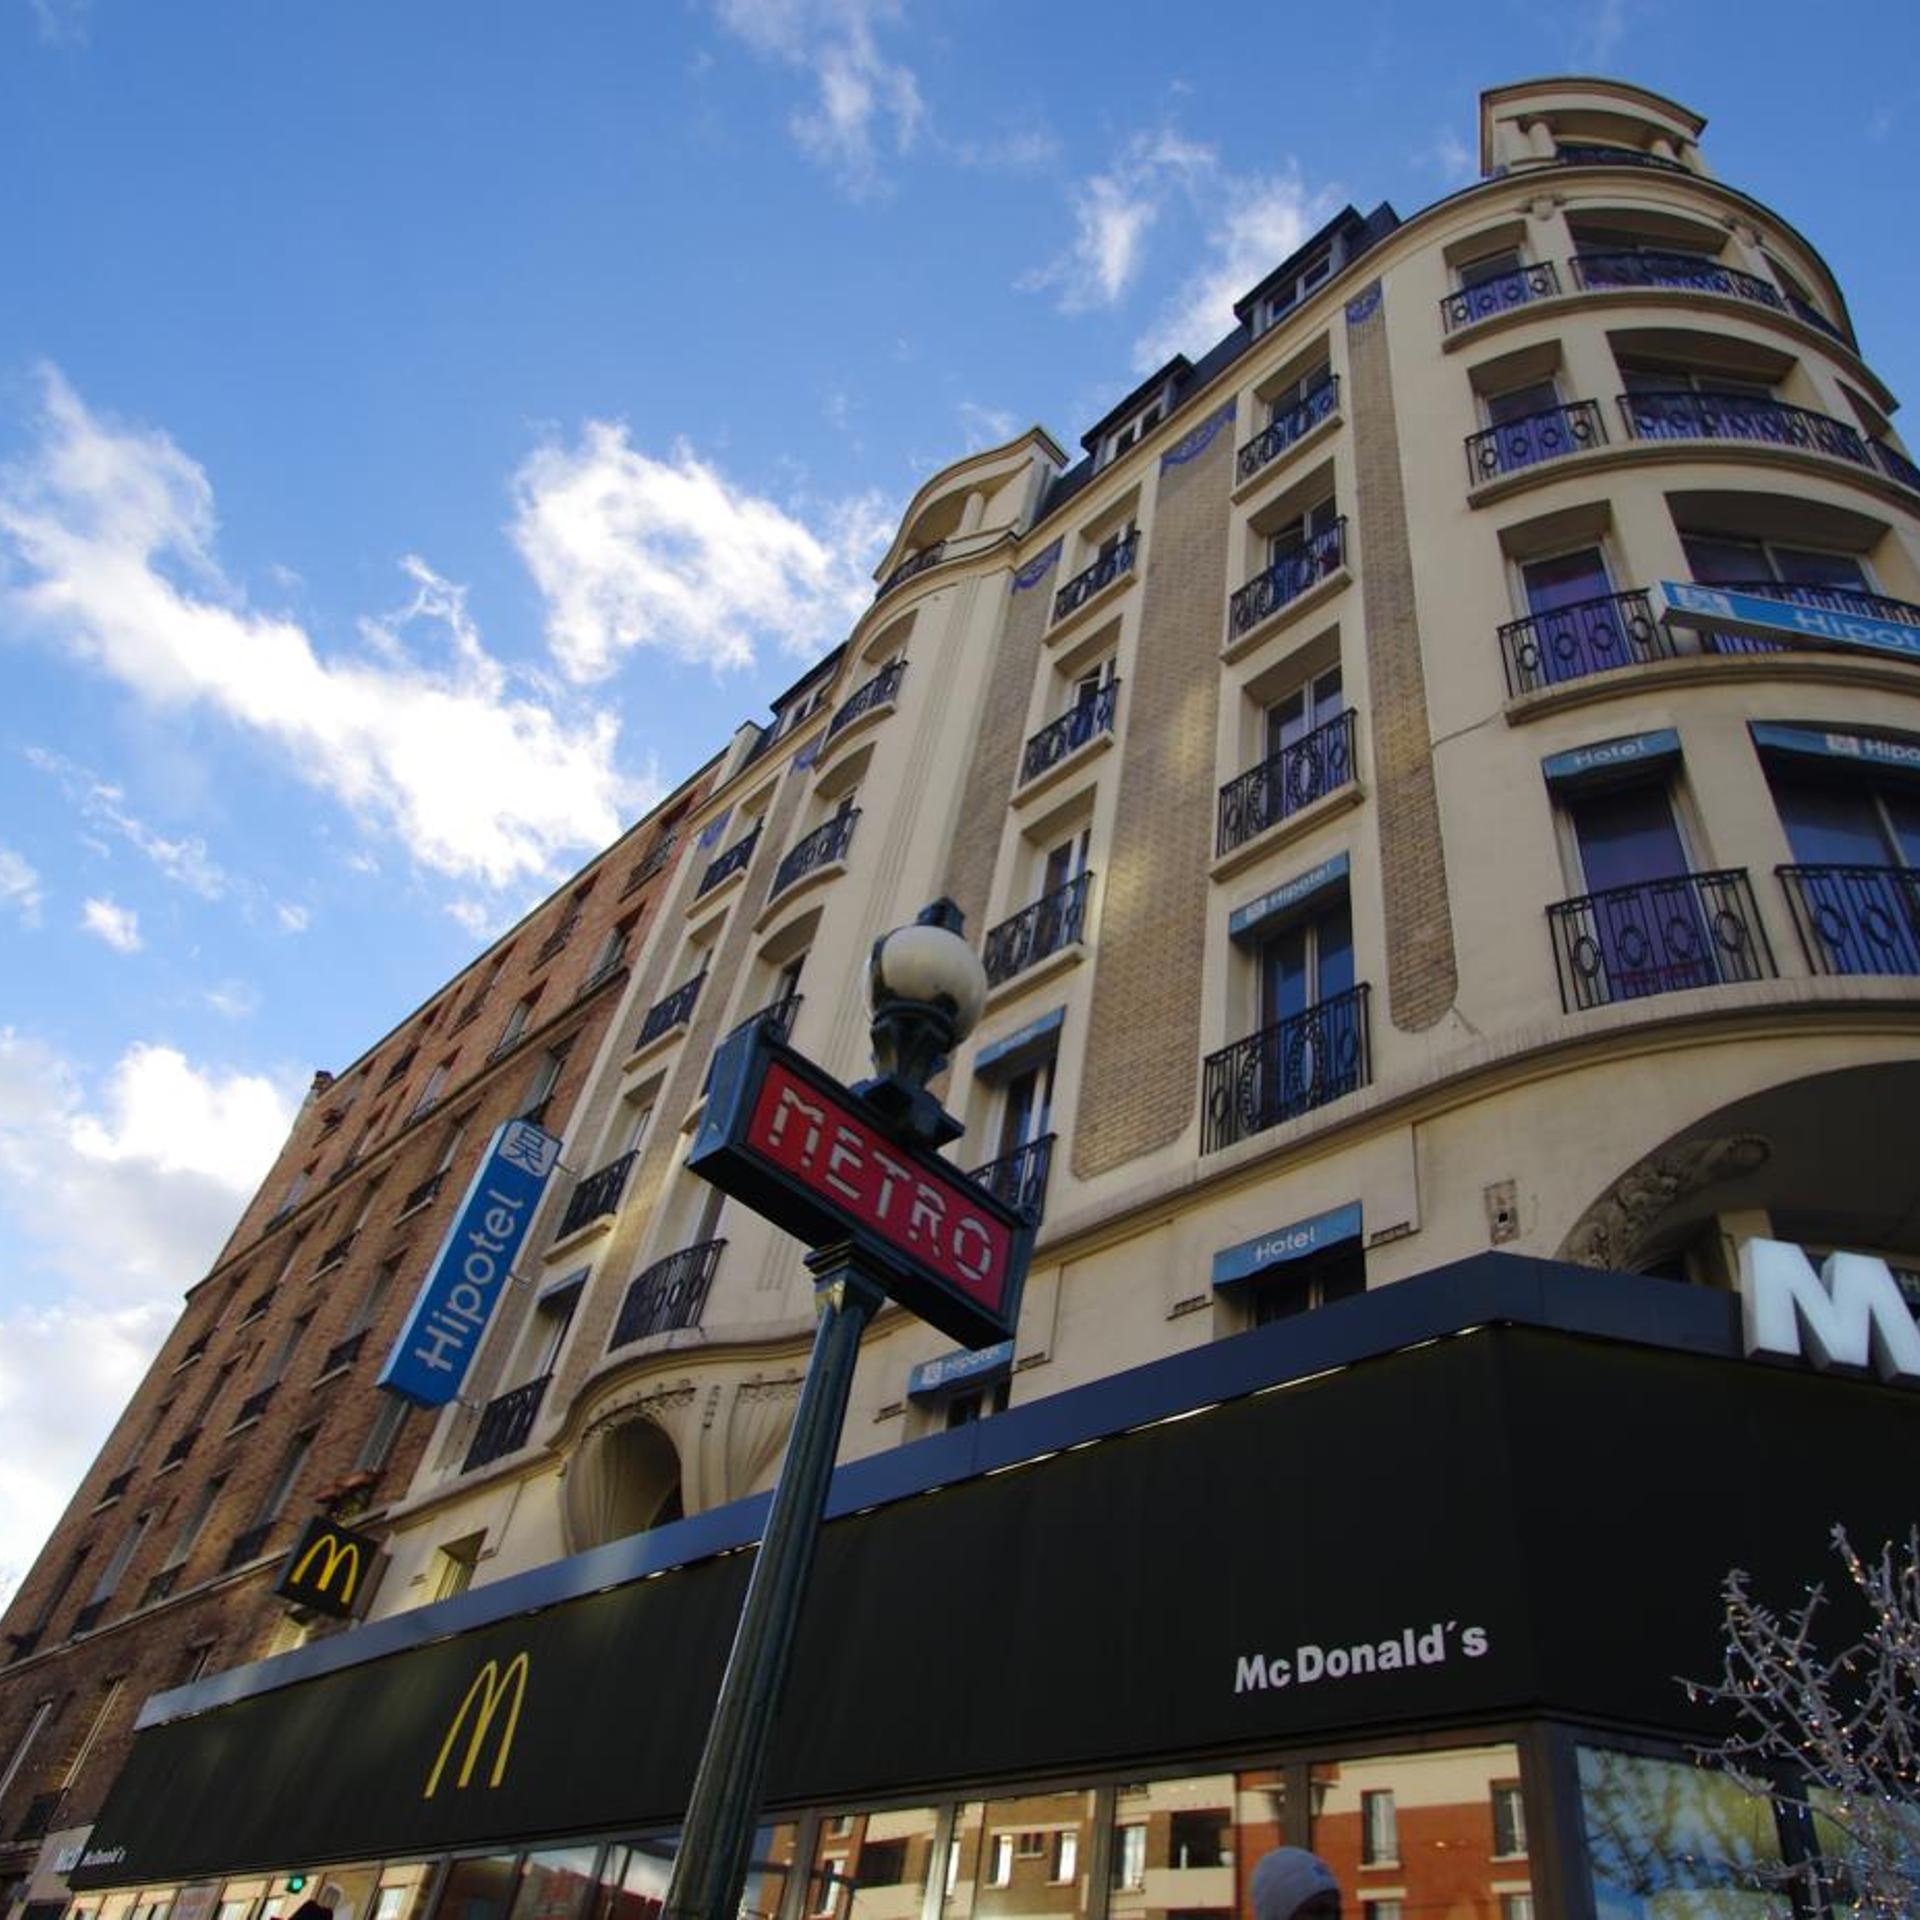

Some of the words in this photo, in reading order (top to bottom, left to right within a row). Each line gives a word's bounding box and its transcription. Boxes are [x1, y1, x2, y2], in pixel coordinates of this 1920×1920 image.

[1575, 740, 1645, 767] Hotel
[1256, 1225, 1316, 1262] Hotel
[414, 1189, 524, 1372] Hipotel
